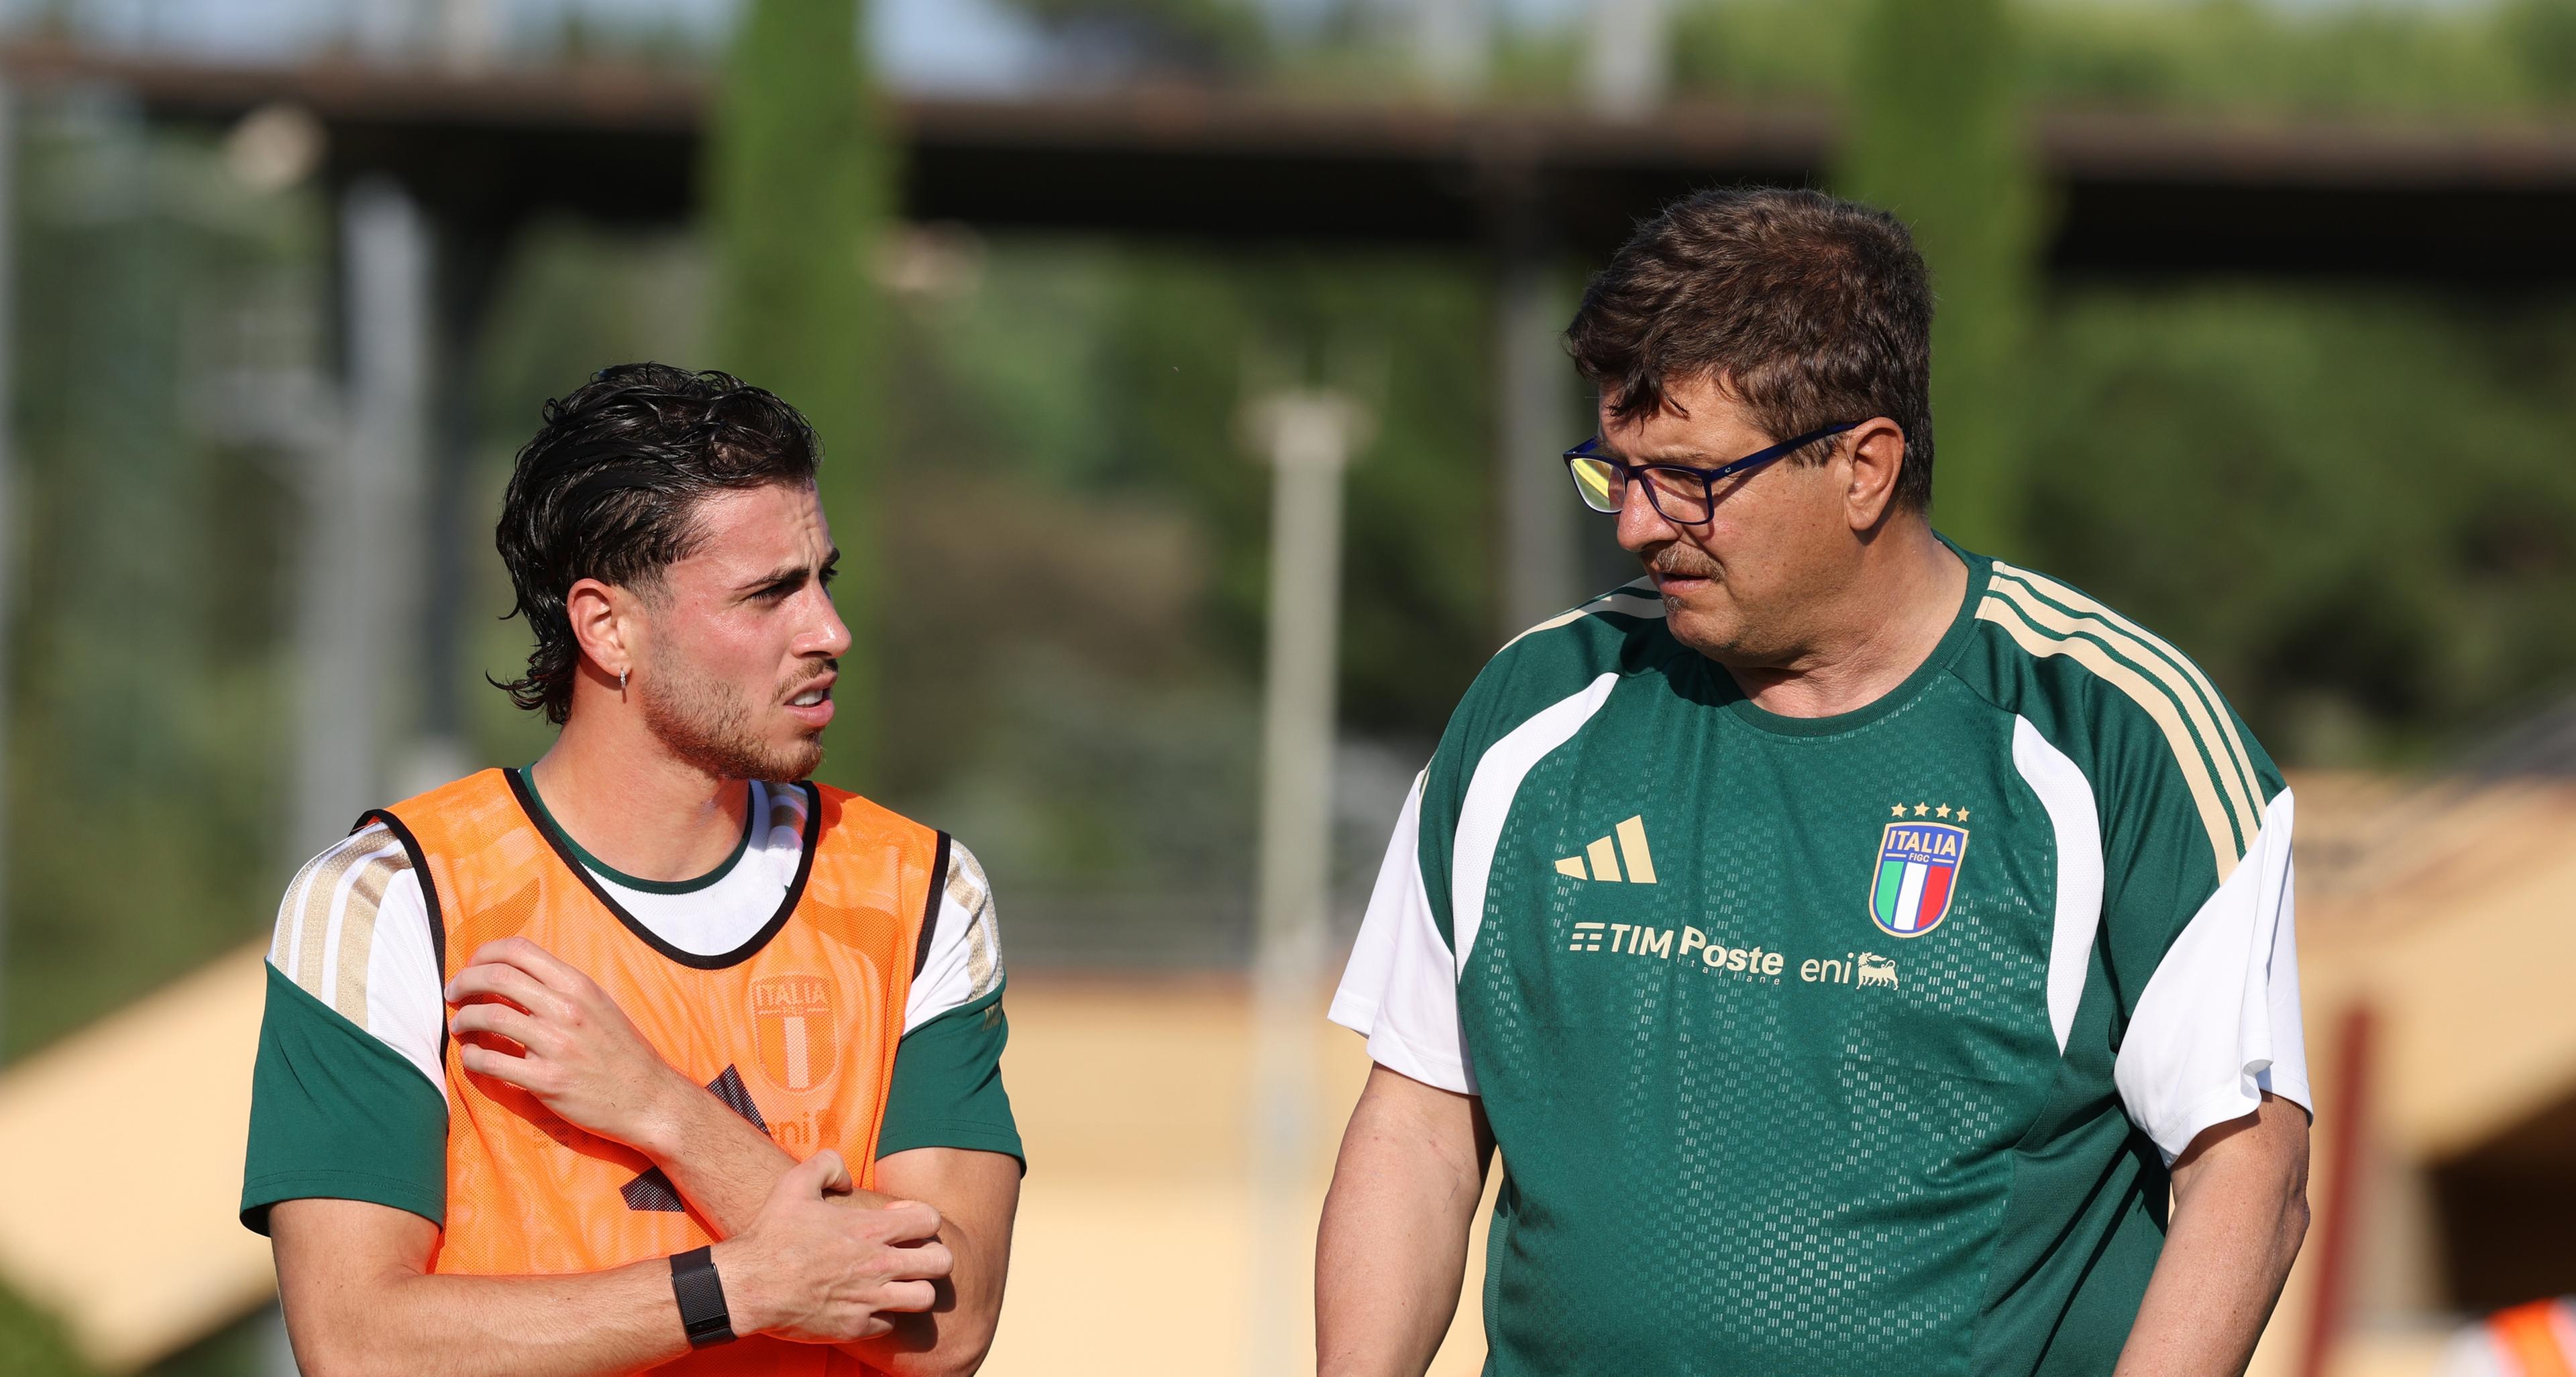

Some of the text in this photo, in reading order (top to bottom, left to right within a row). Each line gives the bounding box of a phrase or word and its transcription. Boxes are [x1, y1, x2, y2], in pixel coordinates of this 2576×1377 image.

[1886, 830, 1956, 857] ITALIA
[1908, 852, 1930, 863] FIGC
[1610, 923, 1854, 984] TIM Poste eni
[1677, 953, 1781, 985] italiane
[755, 983, 828, 1006] ITALIA
